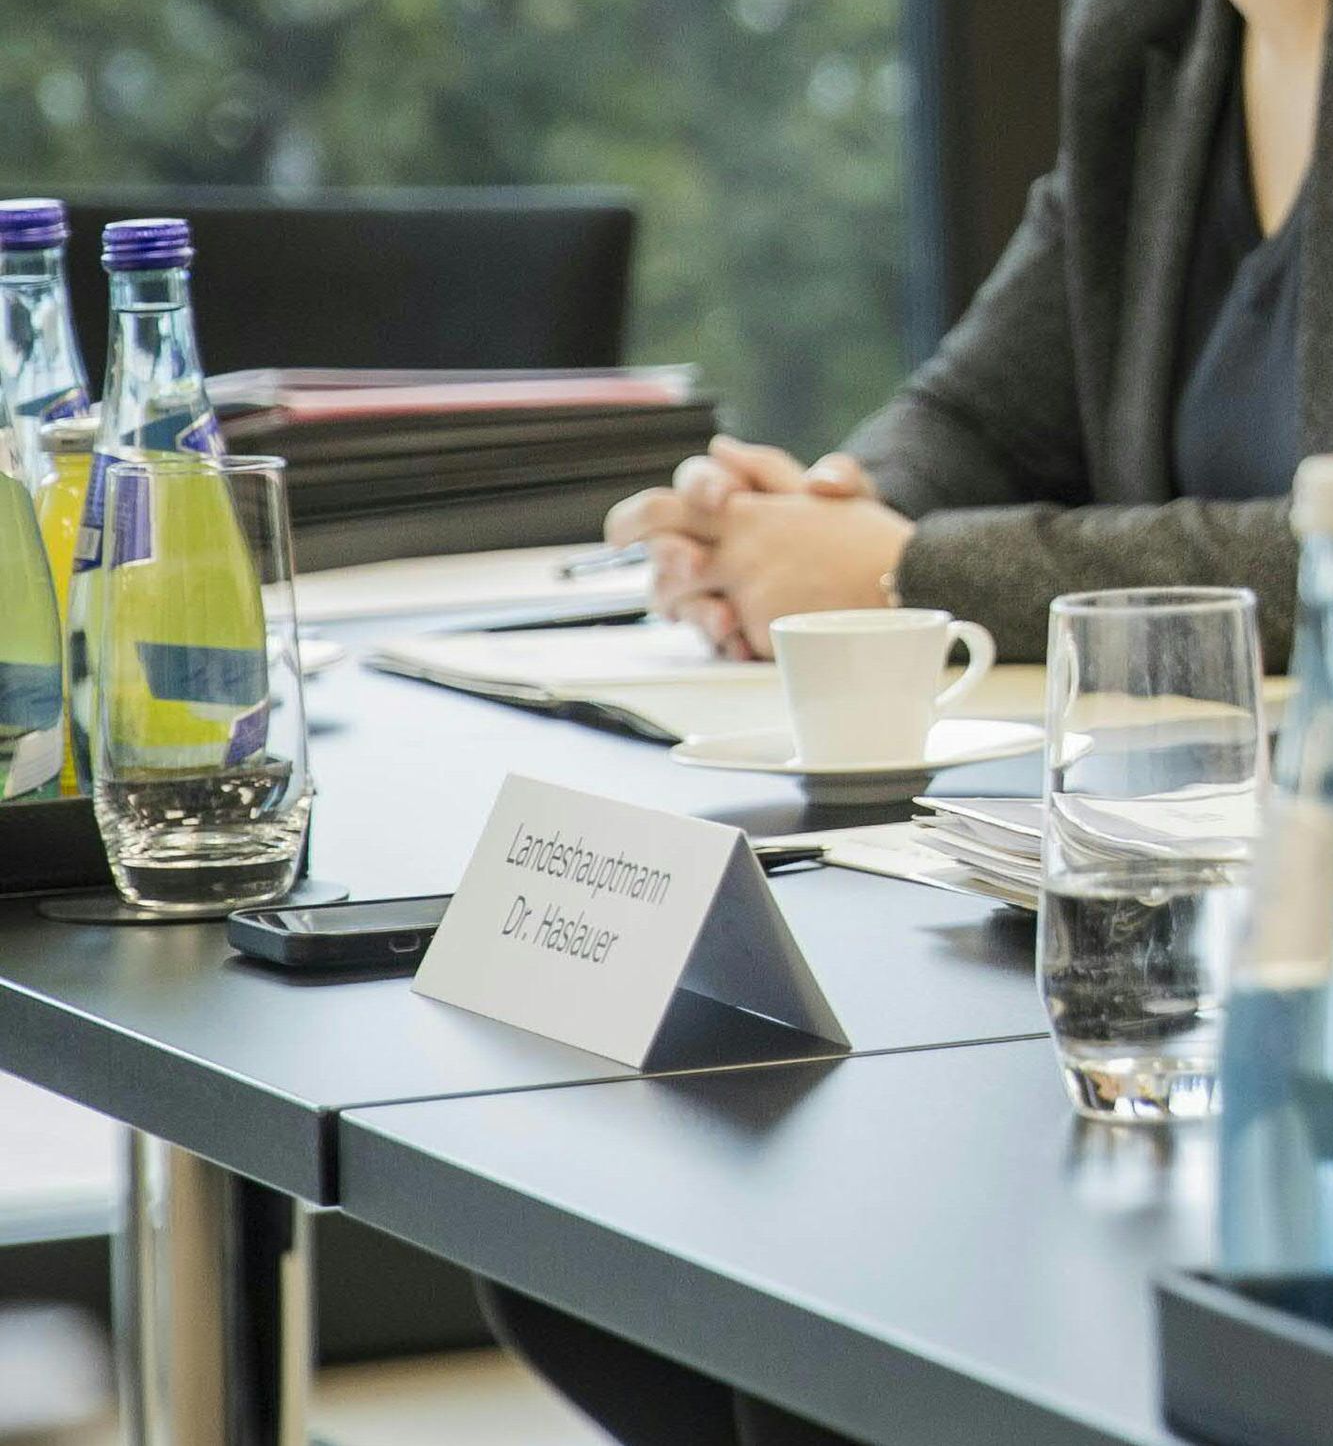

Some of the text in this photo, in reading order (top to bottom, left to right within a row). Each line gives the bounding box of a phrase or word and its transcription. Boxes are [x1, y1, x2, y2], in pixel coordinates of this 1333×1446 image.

[506, 822, 671, 906] Landeshauptmann
[501, 895, 619, 964] Dr. Haslauer
